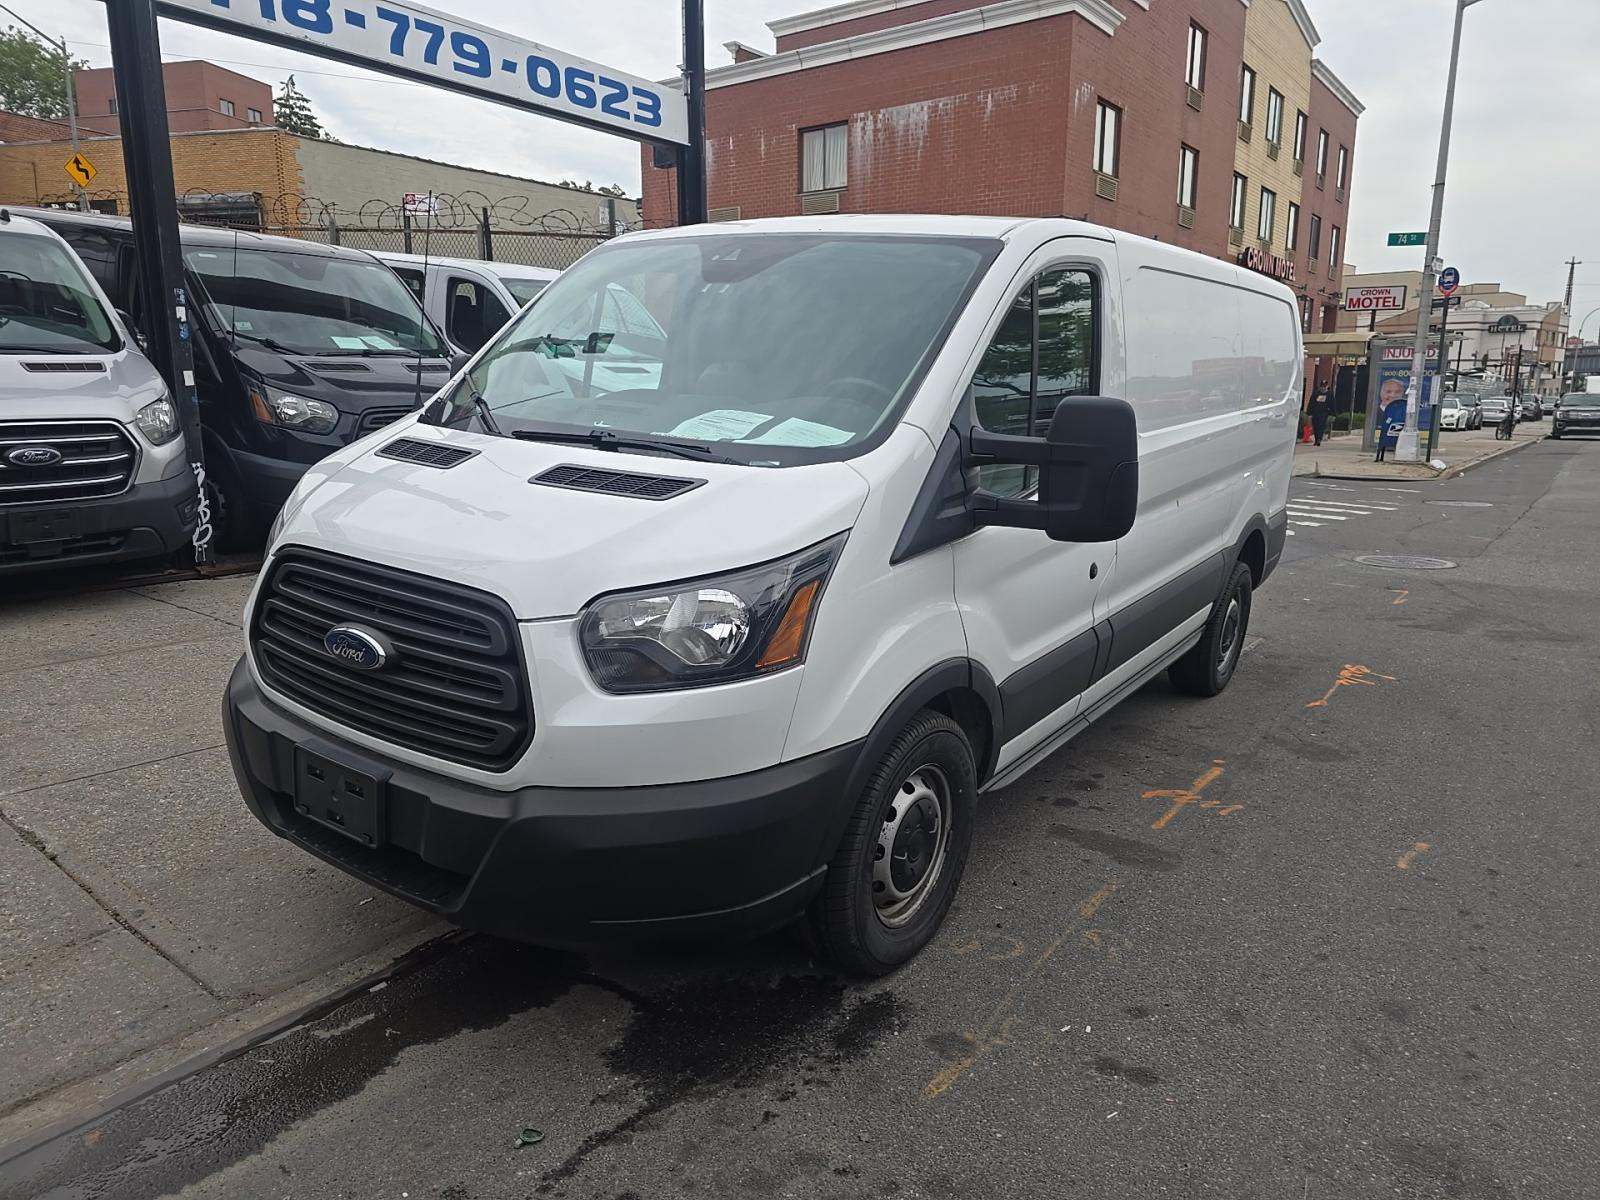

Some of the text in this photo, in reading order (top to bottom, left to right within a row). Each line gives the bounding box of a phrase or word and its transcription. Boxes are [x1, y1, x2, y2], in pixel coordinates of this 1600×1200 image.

[210, 0, 662, 127] 8-779-0623
[1397, 234, 1407, 244] 74
[1247, 247, 1296, 282] CROWN MOTEL
[1360, 289, 1391, 297] CROWN
[1347, 296, 1401, 309] MOTEL
[23, 450, 51, 461] Ford
[333, 634, 366, 663] Ford
